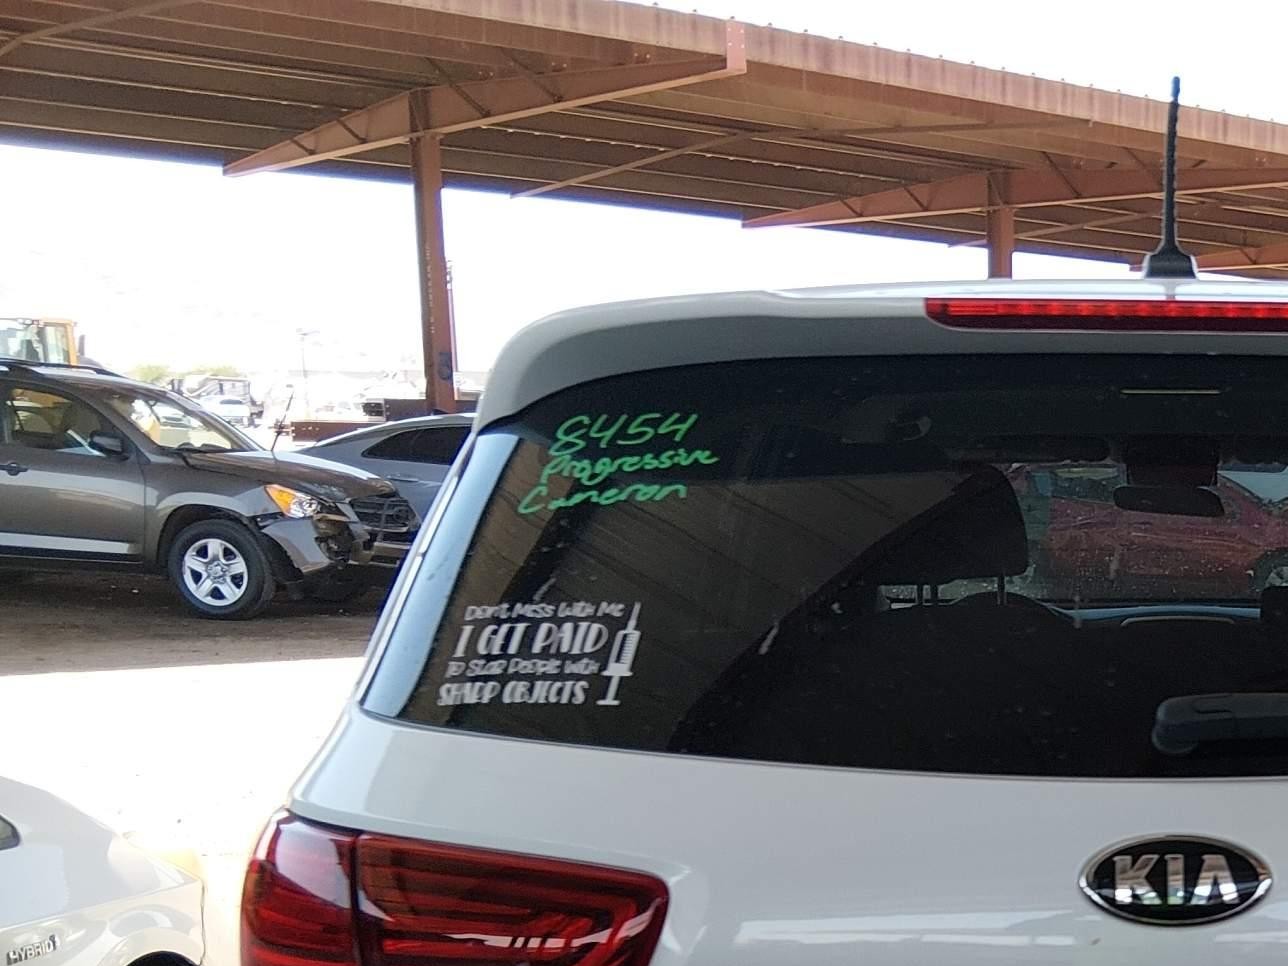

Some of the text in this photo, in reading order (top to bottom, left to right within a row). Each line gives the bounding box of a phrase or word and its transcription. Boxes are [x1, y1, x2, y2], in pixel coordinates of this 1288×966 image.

[548, 412, 699, 456] 8454
[517, 484, 688, 515] Cameron
[451, 621, 609, 657] I GET PAID
[436, 680, 591, 707] SHARP OBJECTS
[1112, 853, 1241, 905] KIA
[5, 934, 57, 966] HYBRID
